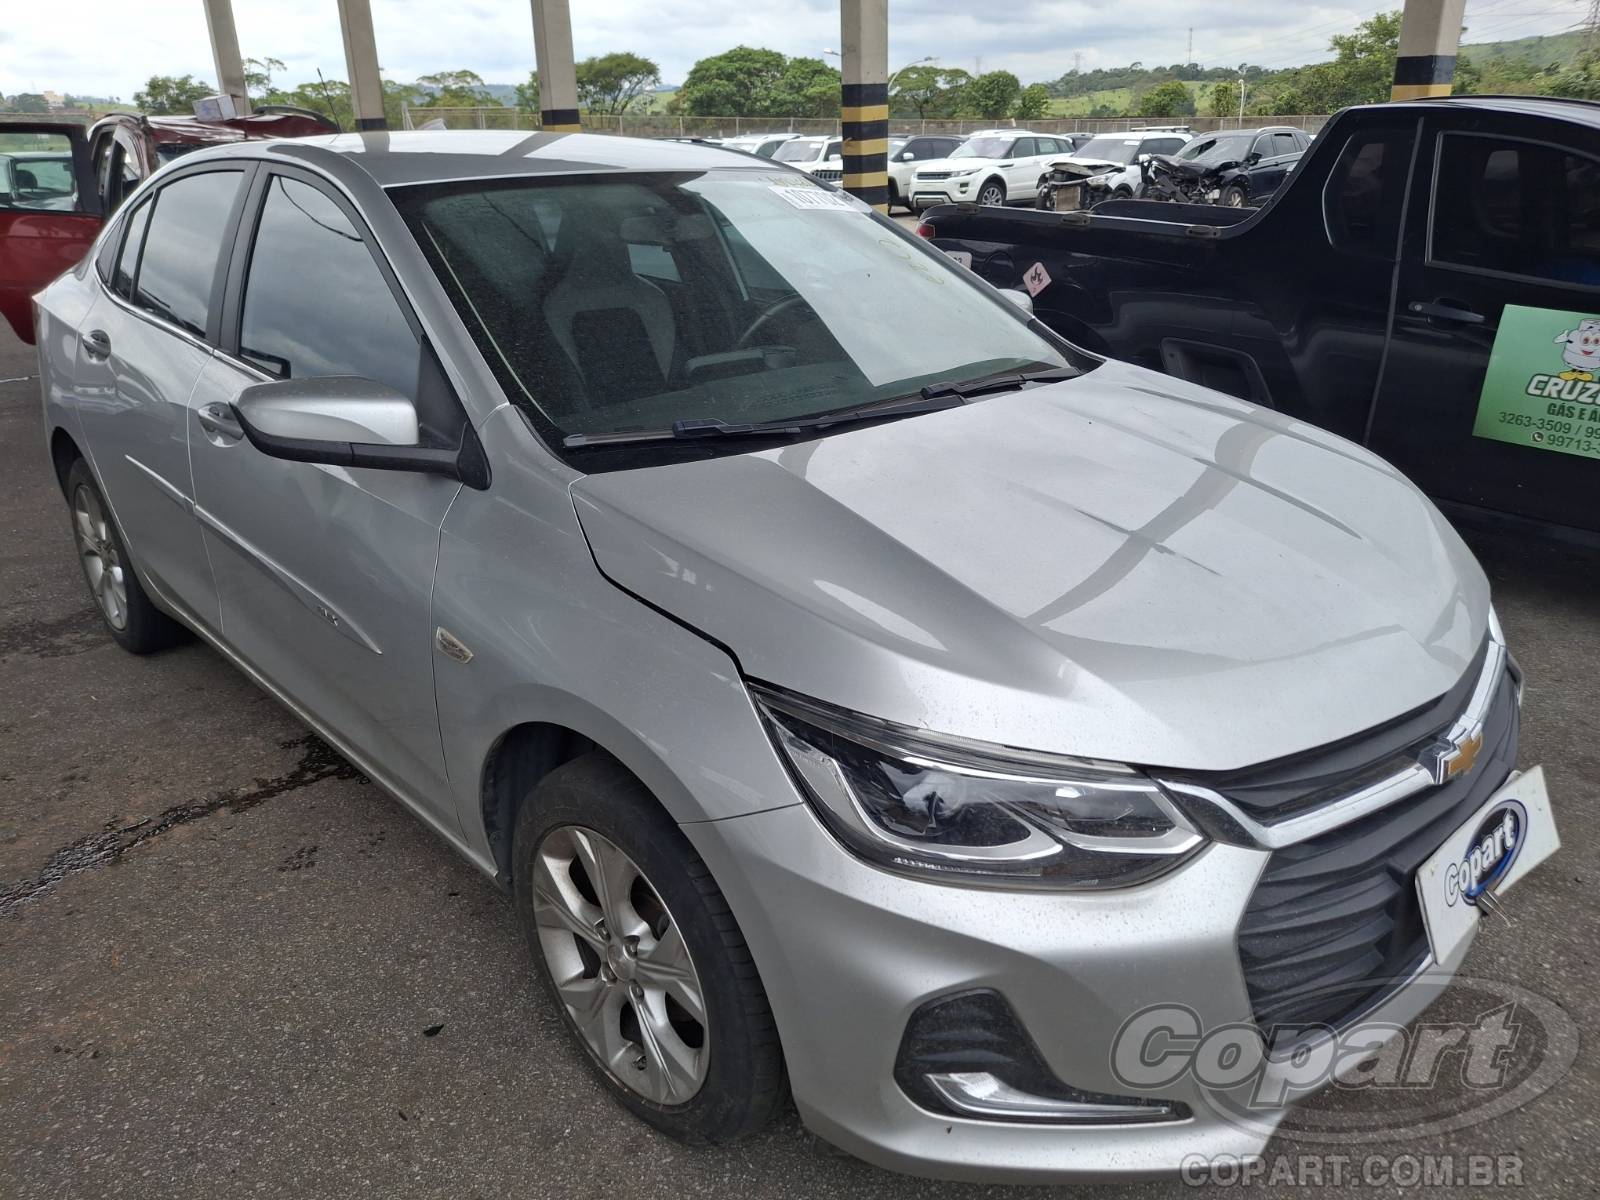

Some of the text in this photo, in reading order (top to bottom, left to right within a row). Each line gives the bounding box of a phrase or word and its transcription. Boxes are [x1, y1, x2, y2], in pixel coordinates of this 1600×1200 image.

[1526, 373, 1600, 406] CRUZ
[1499, 413, 1572, 434] 3263-3509
[1547, 403, 1575, 419] GÁS
[1578, 408, 1587, 420] E
[1444, 807, 1515, 907] Copart
